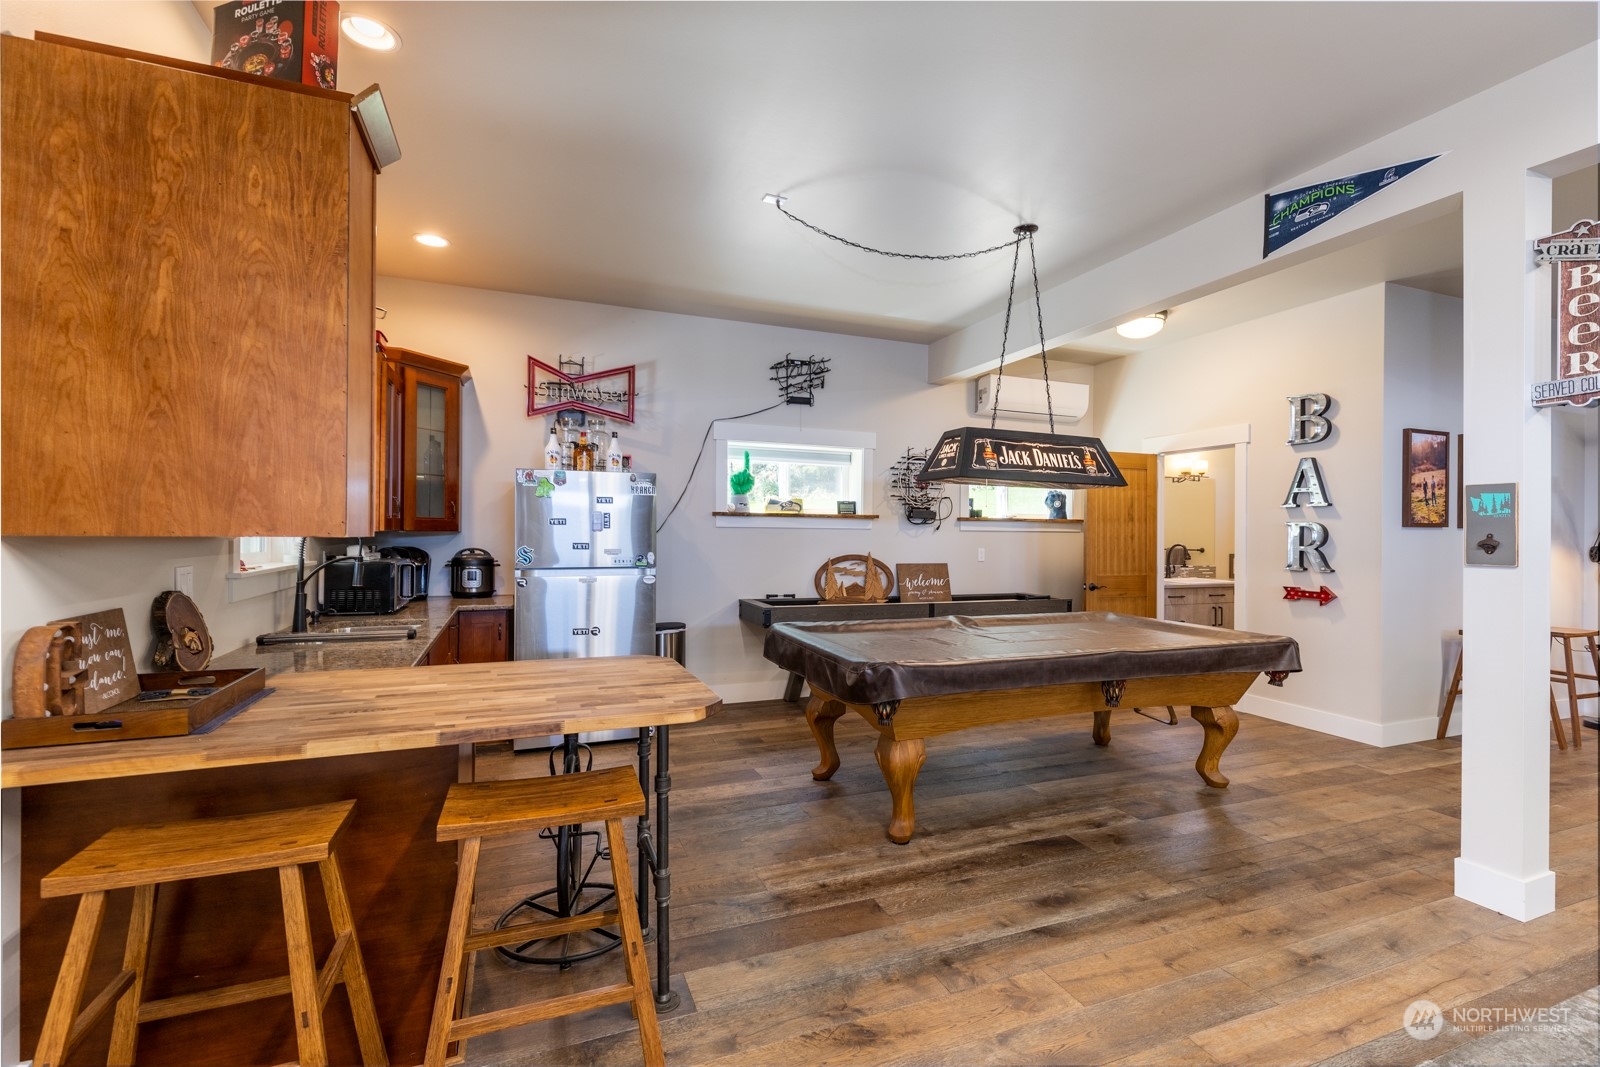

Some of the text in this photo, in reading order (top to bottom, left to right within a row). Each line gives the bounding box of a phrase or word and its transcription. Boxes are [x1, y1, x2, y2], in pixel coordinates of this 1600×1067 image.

[240, 7, 275, 22] PARTY GAME
[1272, 184, 1355, 226] CHAMPIONS
[1290, 221, 1309, 231] SEATTLE
[1534, 380, 1575, 399] SERVED
[999, 446, 1033, 466] JACK
[1281, 393, 1336, 572] BAR
[899, 574, 949, 590] welcome
[105, 627, 124, 638] me,
[105, 649, 124, 661] can
[84, 656, 126, 691] dance!
